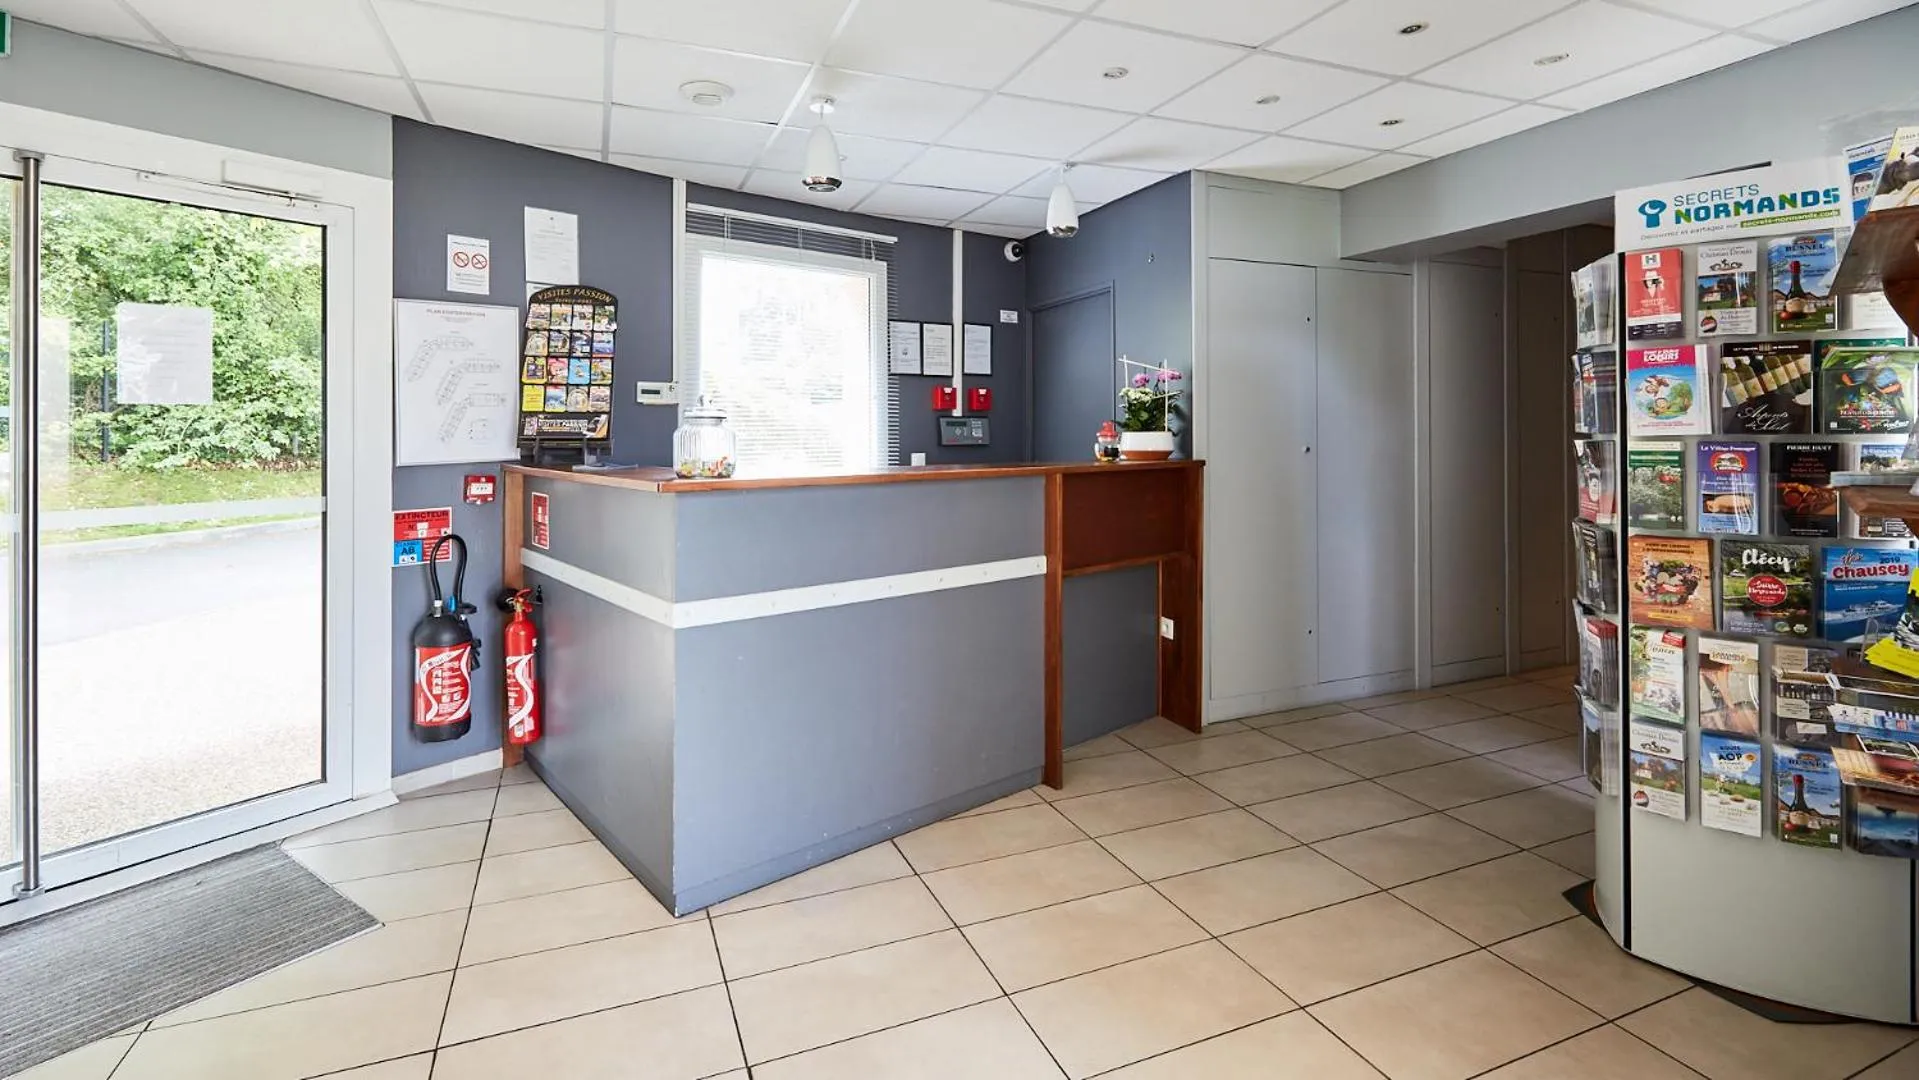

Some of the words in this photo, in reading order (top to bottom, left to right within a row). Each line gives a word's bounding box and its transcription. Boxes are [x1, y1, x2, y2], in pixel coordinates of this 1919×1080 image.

[1674, 183, 1759, 207] SECRETS
[1675, 187, 1840, 224] NORMANDS
[1742, 210, 1839, 227] secrets-normands.com
[537, 288, 570, 300] VISITES
[573, 287, 613, 303] PASSION
[394, 510, 449, 520] EXTINCTEUR
[1742, 548, 1792, 573] Clécy
[1832, 563, 1910, 579] Chausey
[1718, 752, 1743, 762] AOP
